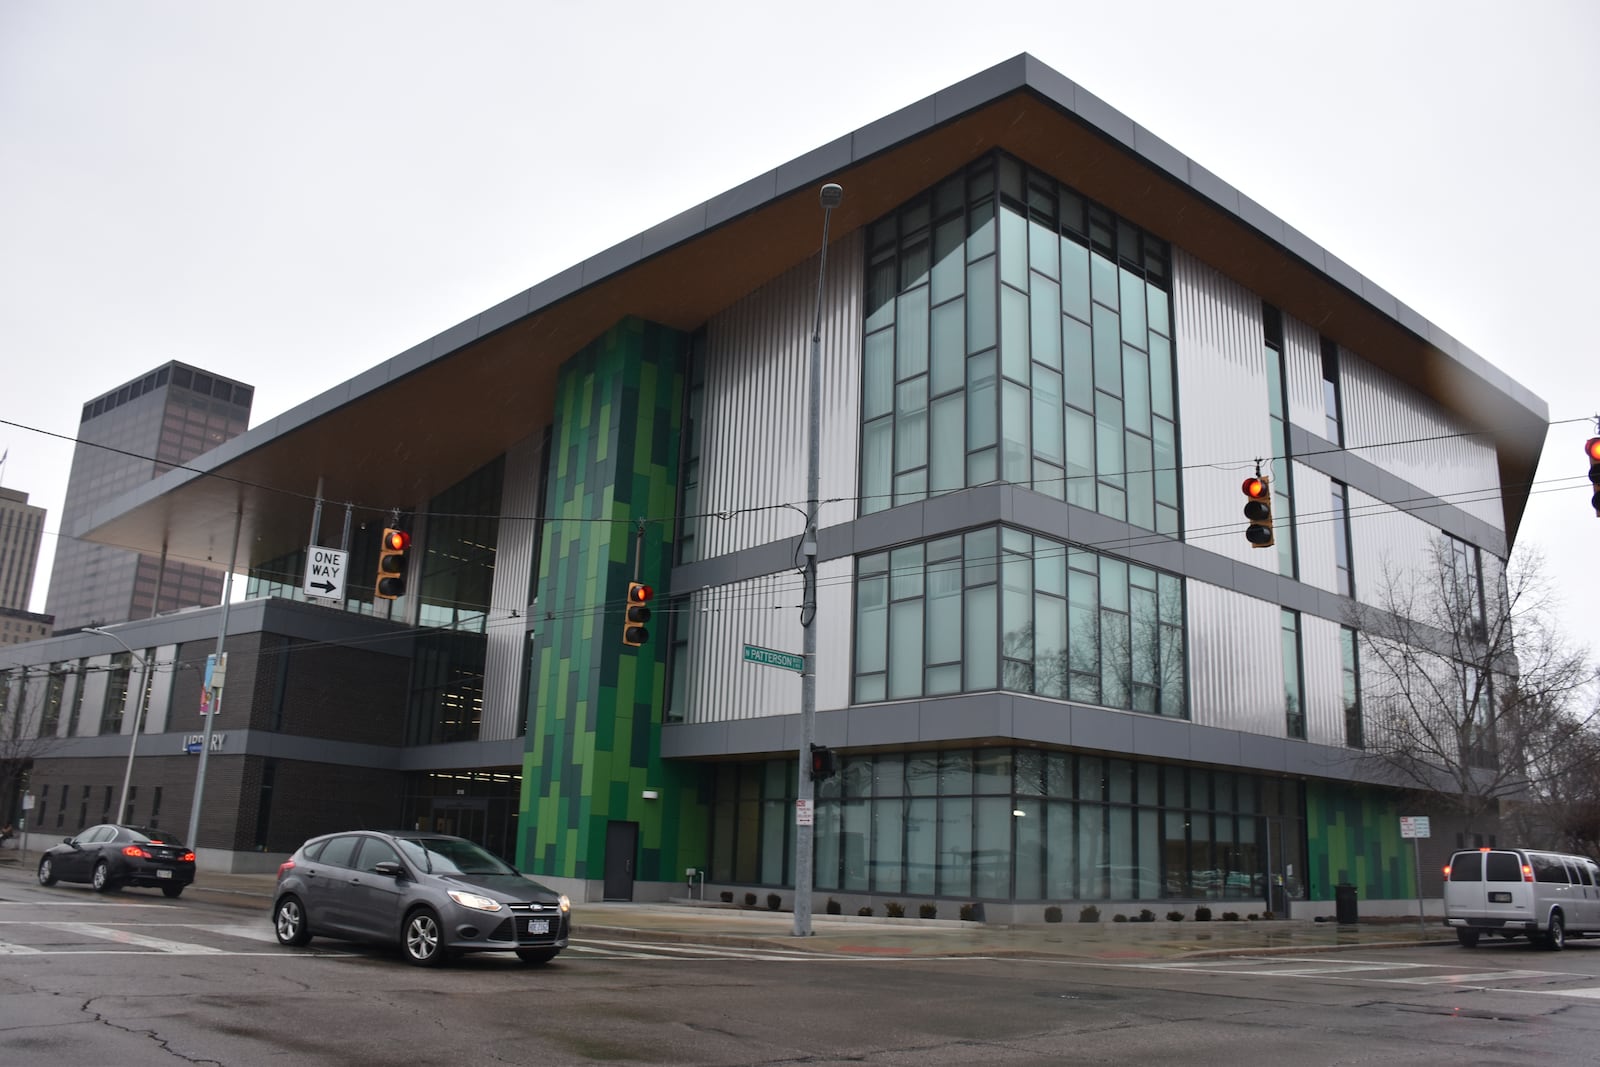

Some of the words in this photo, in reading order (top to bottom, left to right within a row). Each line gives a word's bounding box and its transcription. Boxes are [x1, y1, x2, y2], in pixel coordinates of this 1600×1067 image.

[315, 551, 340, 566] ONE
[312, 564, 340, 578] WAY
[751, 649, 792, 667] PATTERSON
